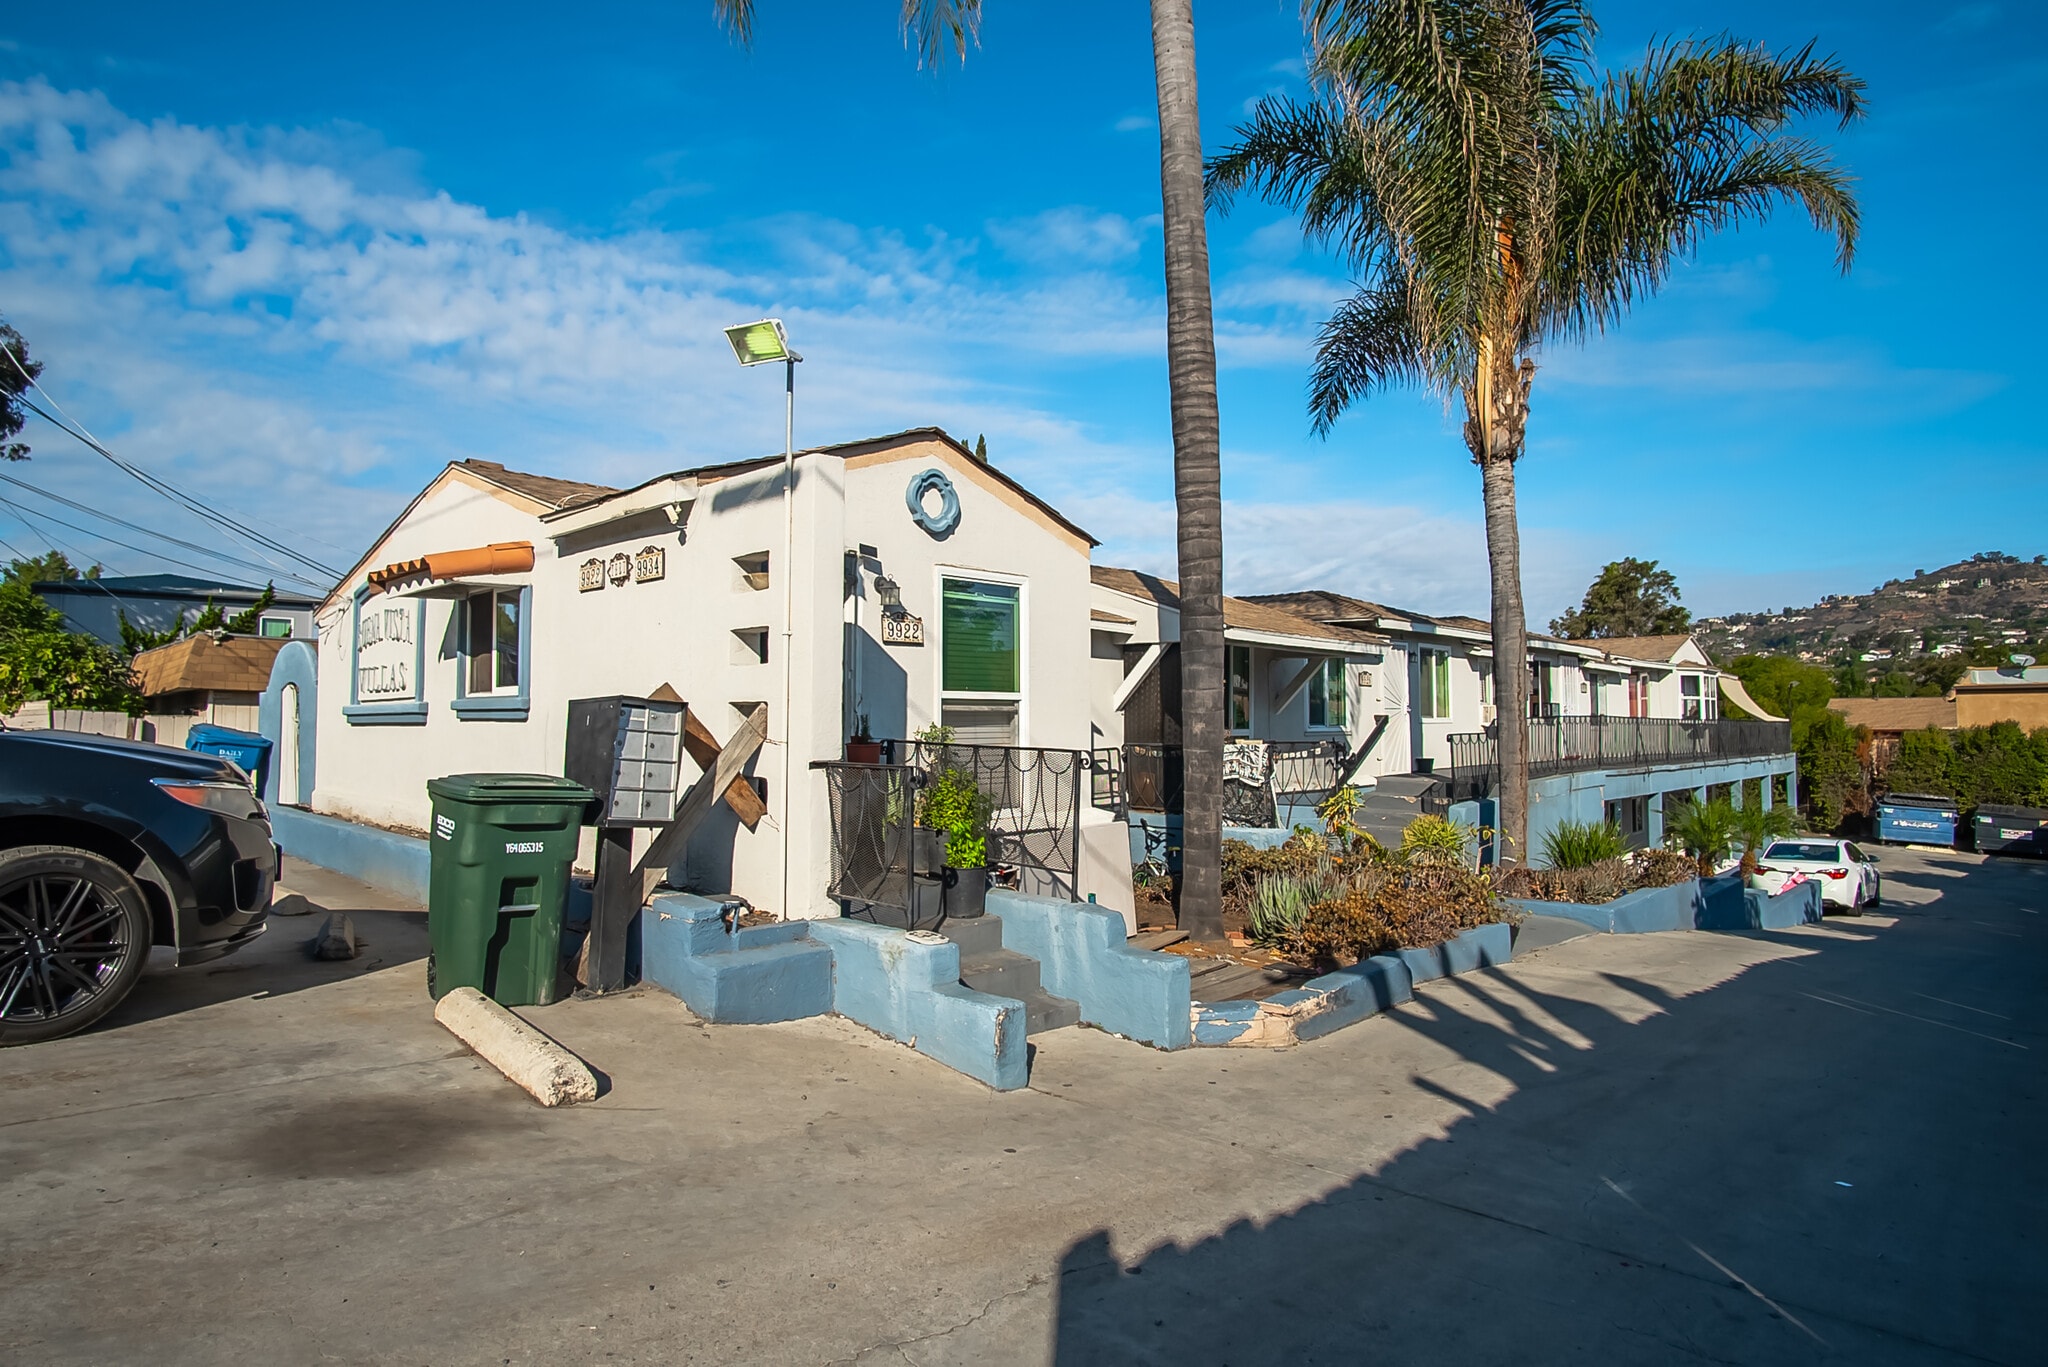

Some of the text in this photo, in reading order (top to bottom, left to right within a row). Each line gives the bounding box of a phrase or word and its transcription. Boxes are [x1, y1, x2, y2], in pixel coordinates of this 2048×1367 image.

[637, 557, 659, 577] 9934
[887, 621, 919, 639] 9922
[358, 662, 408, 694] VILLAS
